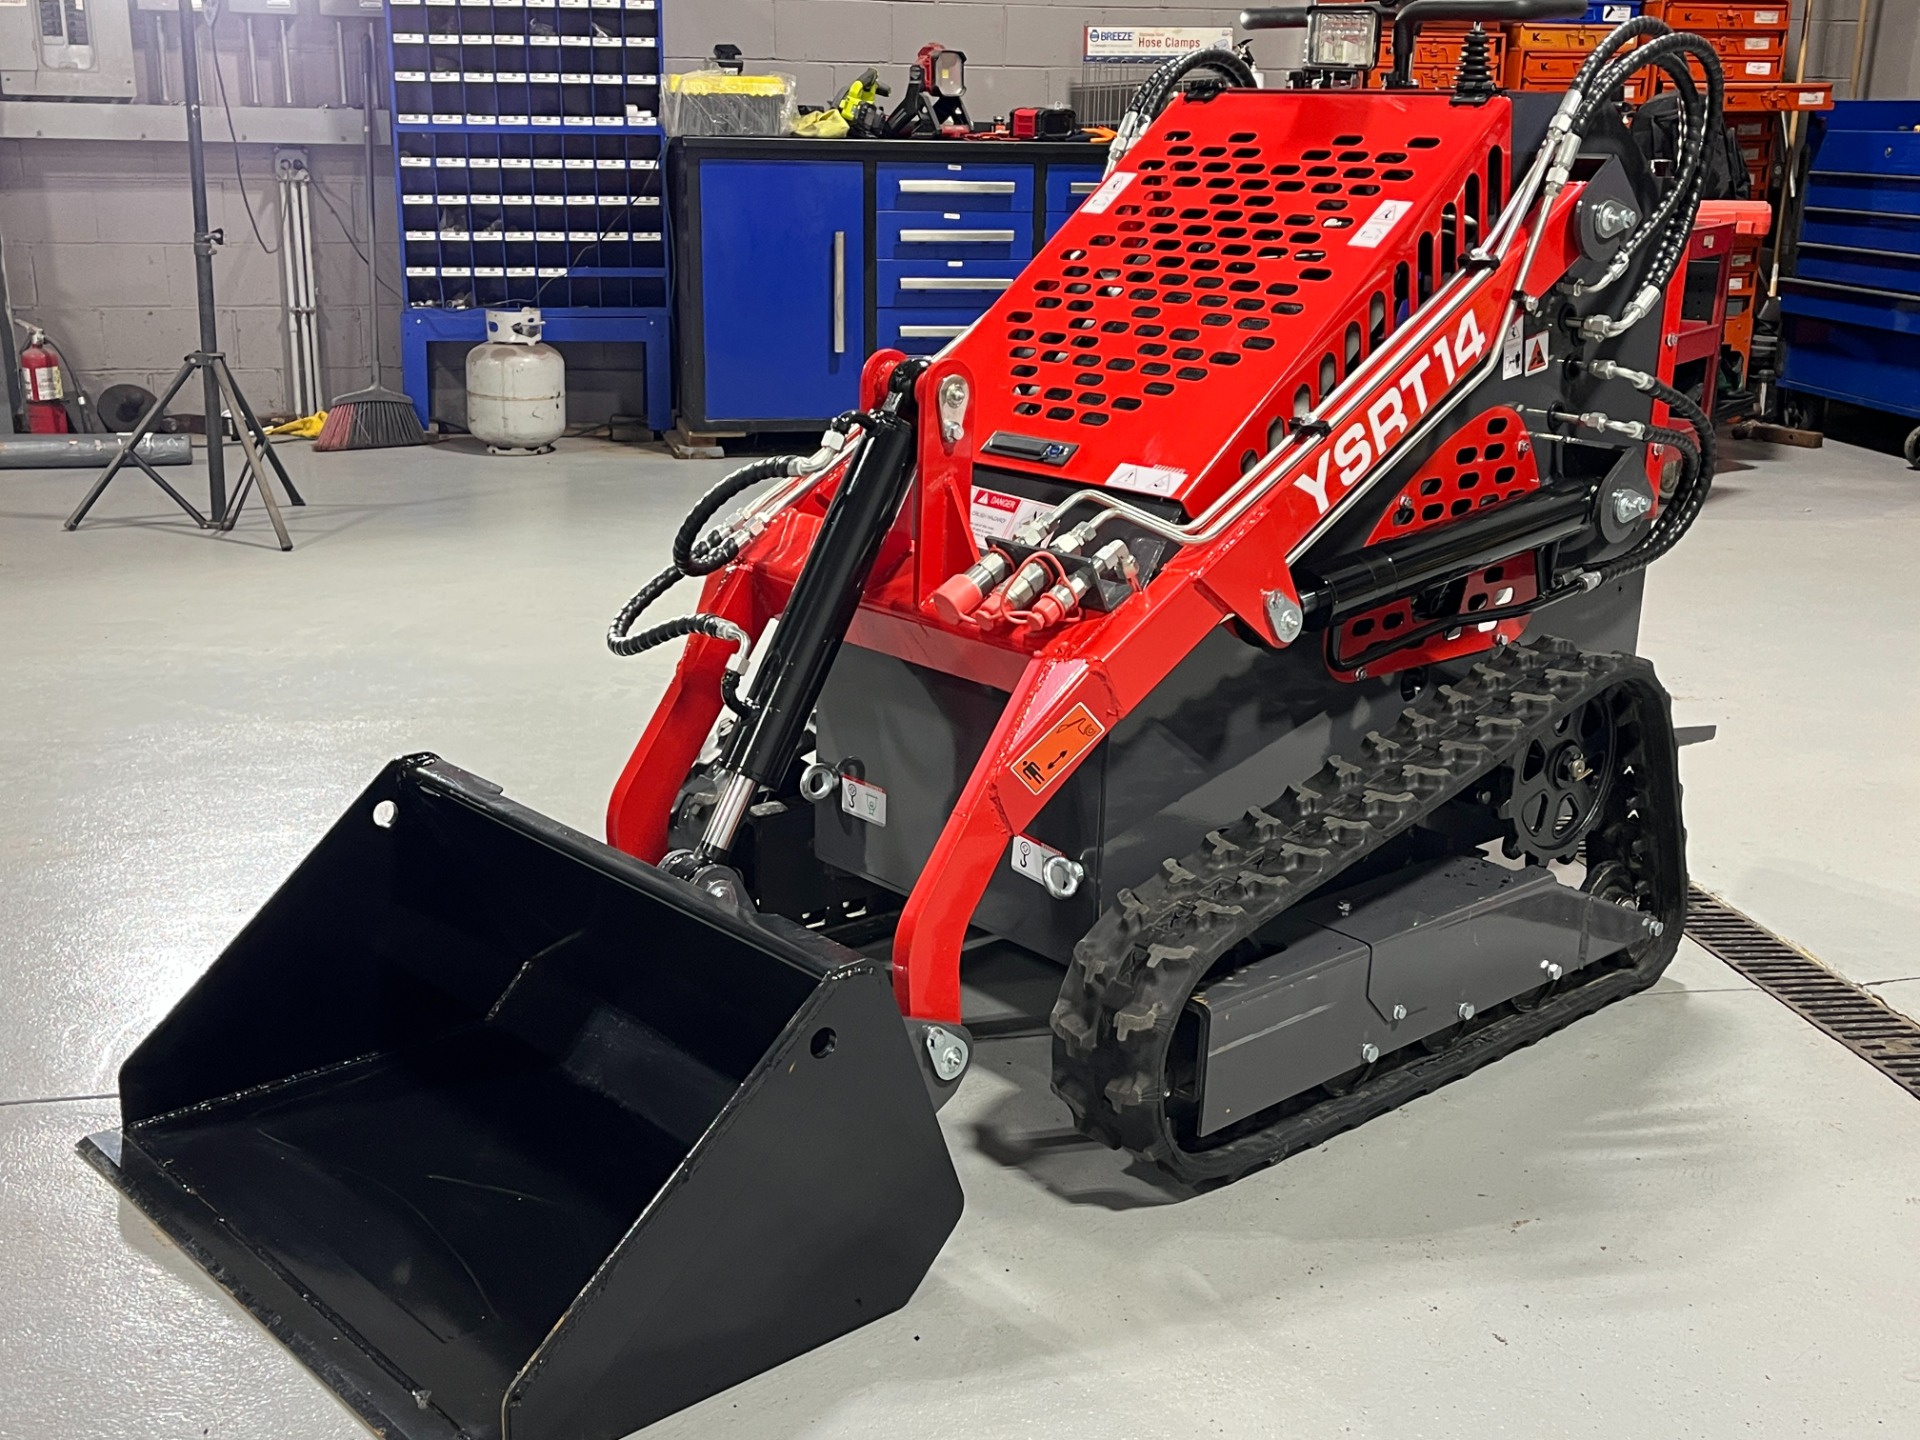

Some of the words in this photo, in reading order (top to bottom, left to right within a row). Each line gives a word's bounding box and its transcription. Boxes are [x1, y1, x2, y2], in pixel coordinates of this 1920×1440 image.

[1101, 31, 1133, 41] BREEZE
[1138, 37, 1162, 48] Hose
[1165, 37, 1201, 50] Clamps
[1293, 309, 1486, 515] YSRT14
[990, 495, 1016, 509] DANGER
